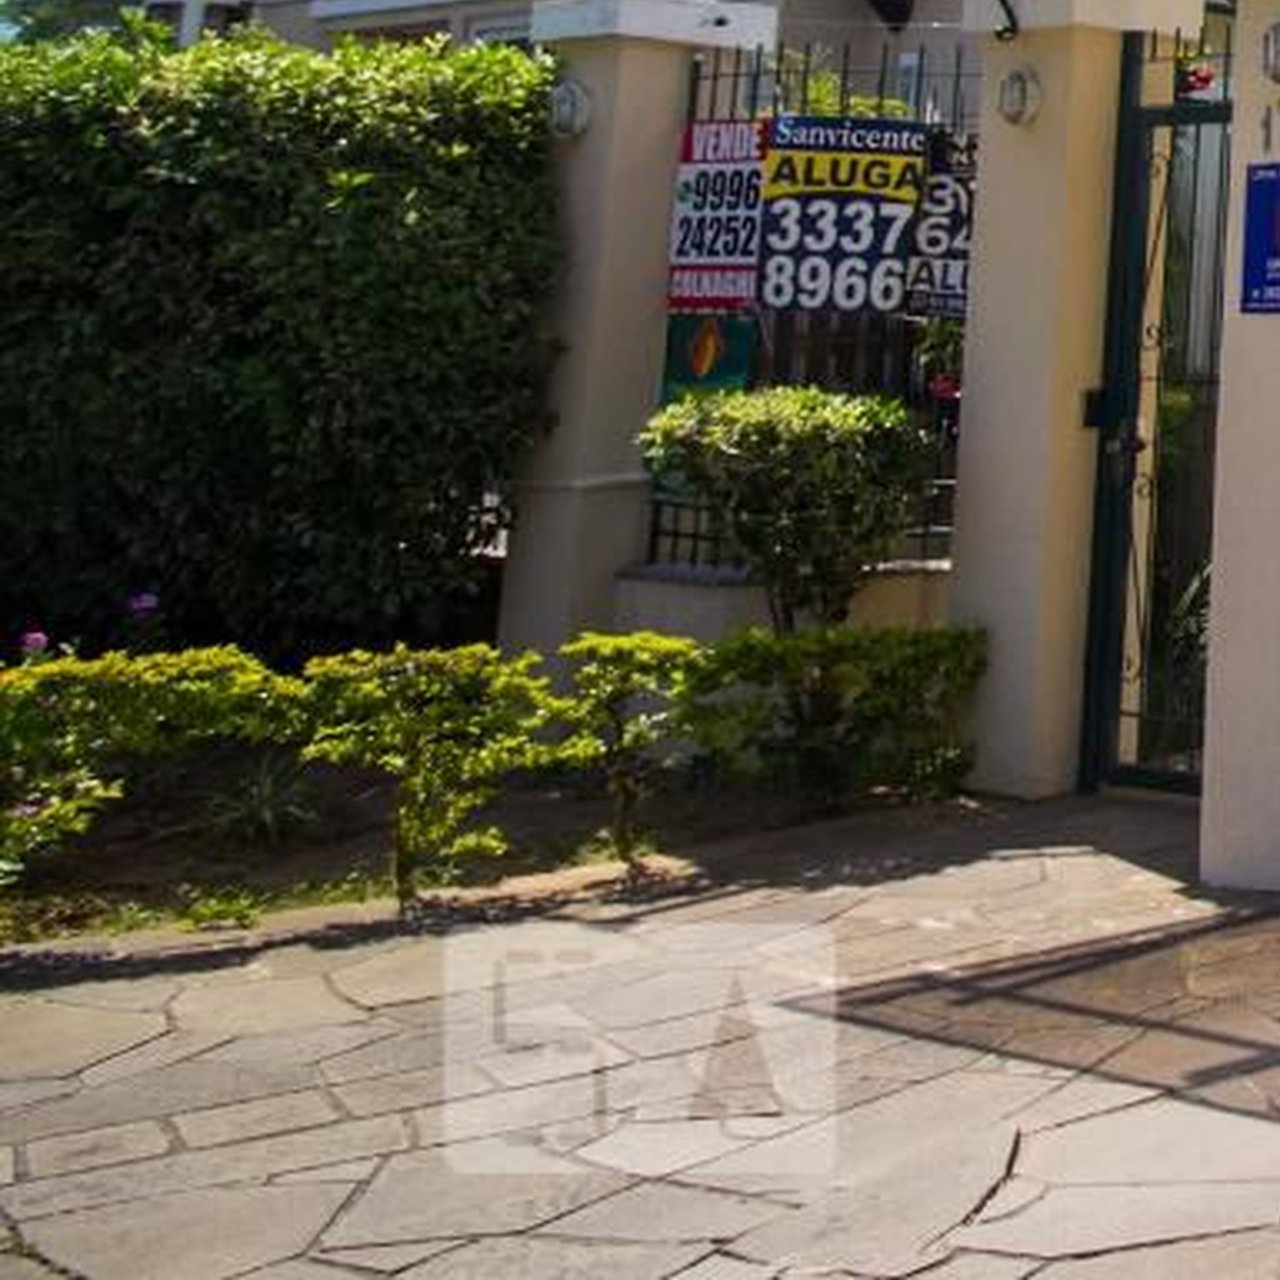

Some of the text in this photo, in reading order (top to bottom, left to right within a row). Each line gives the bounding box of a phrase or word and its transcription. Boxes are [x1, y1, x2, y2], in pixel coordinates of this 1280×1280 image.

[692, 123, 761, 160] VENDE
[776, 117, 925, 150] Sanvicente
[693, 170, 761, 211] 9996
[771, 157, 924, 191] ALUGA
[676, 216, 757, 257] 24252
[766, 199, 914, 254] 3337
[763, 256, 904, 310] 8966
